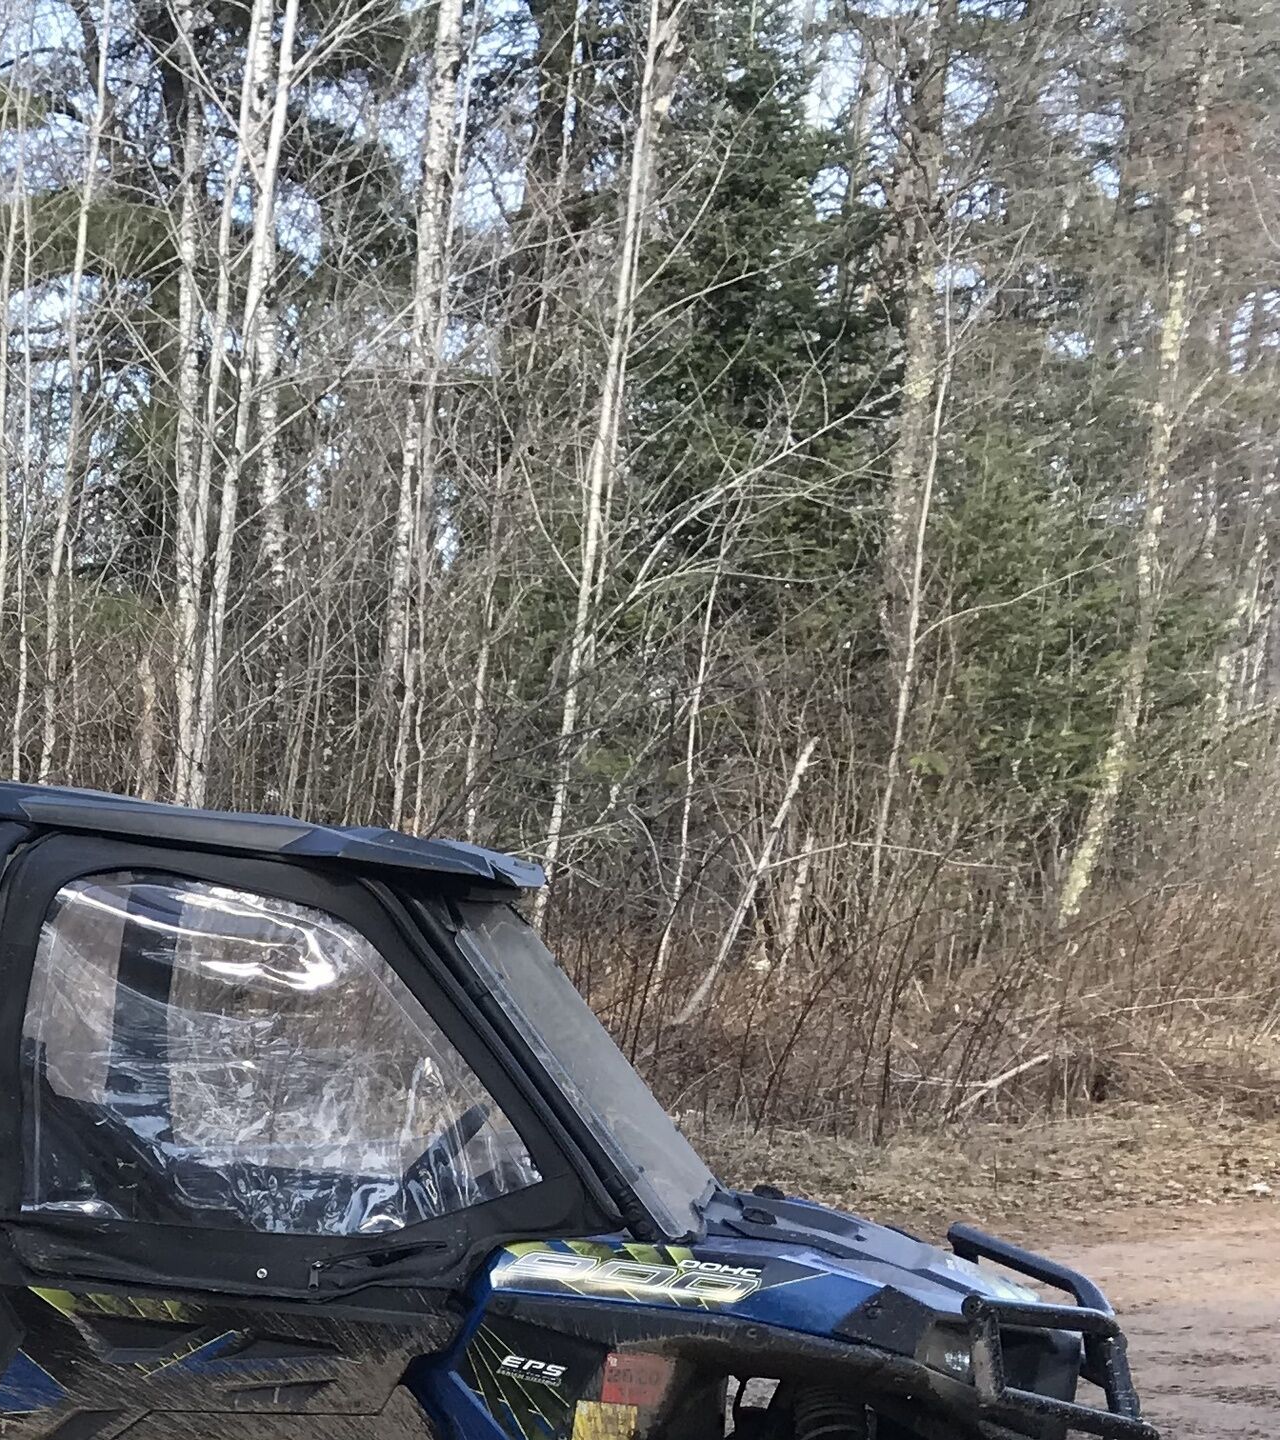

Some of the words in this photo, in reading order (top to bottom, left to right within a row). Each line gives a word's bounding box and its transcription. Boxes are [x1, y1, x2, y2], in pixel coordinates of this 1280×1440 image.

[504, 1250, 762, 1304] 900
[678, 1259, 762, 1278] DOHC
[502, 1355, 568, 1377] EPS
